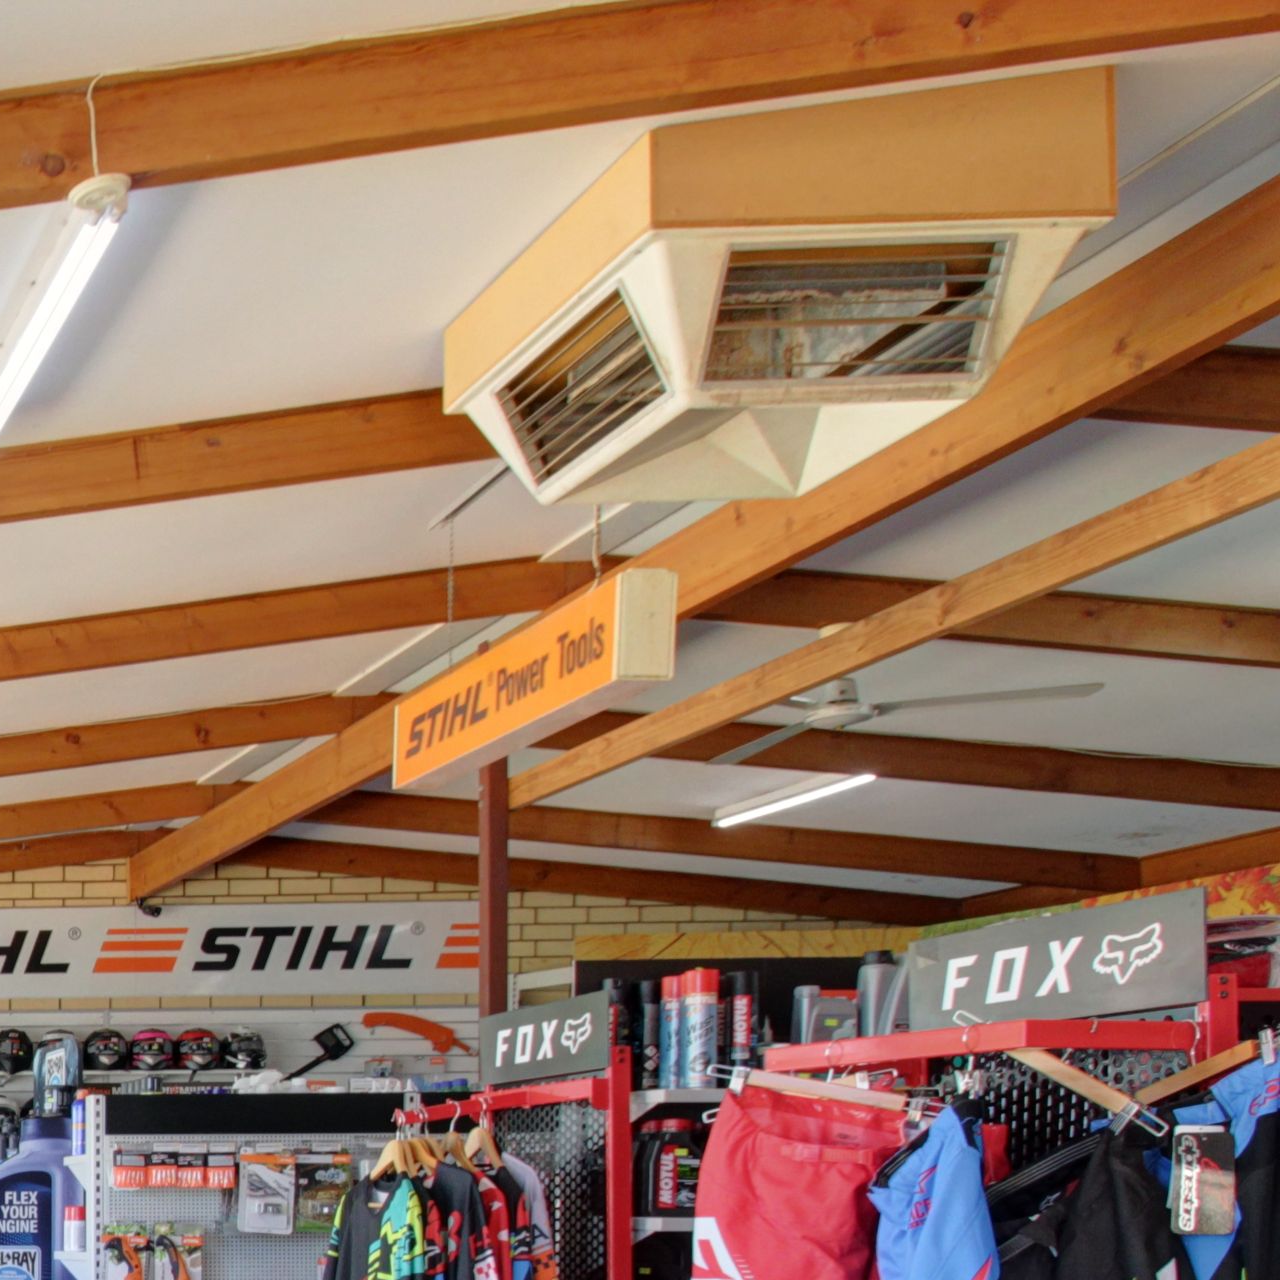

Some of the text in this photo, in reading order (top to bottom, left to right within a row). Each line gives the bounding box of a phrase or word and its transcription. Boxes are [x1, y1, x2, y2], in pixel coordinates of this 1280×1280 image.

[405, 616, 606, 760] STIHL Power Tools
[191, 925, 415, 973] STIHL
[939, 934, 1084, 1011] FOX
[494, 1018, 559, 1068] FOX
[733, 998, 748, 1043] MOTUL
[4, 1191, 38, 1204] FLEX
[659, 1151, 676, 1204] MOTUL
[0, 1205, 38, 1219] YOUR
